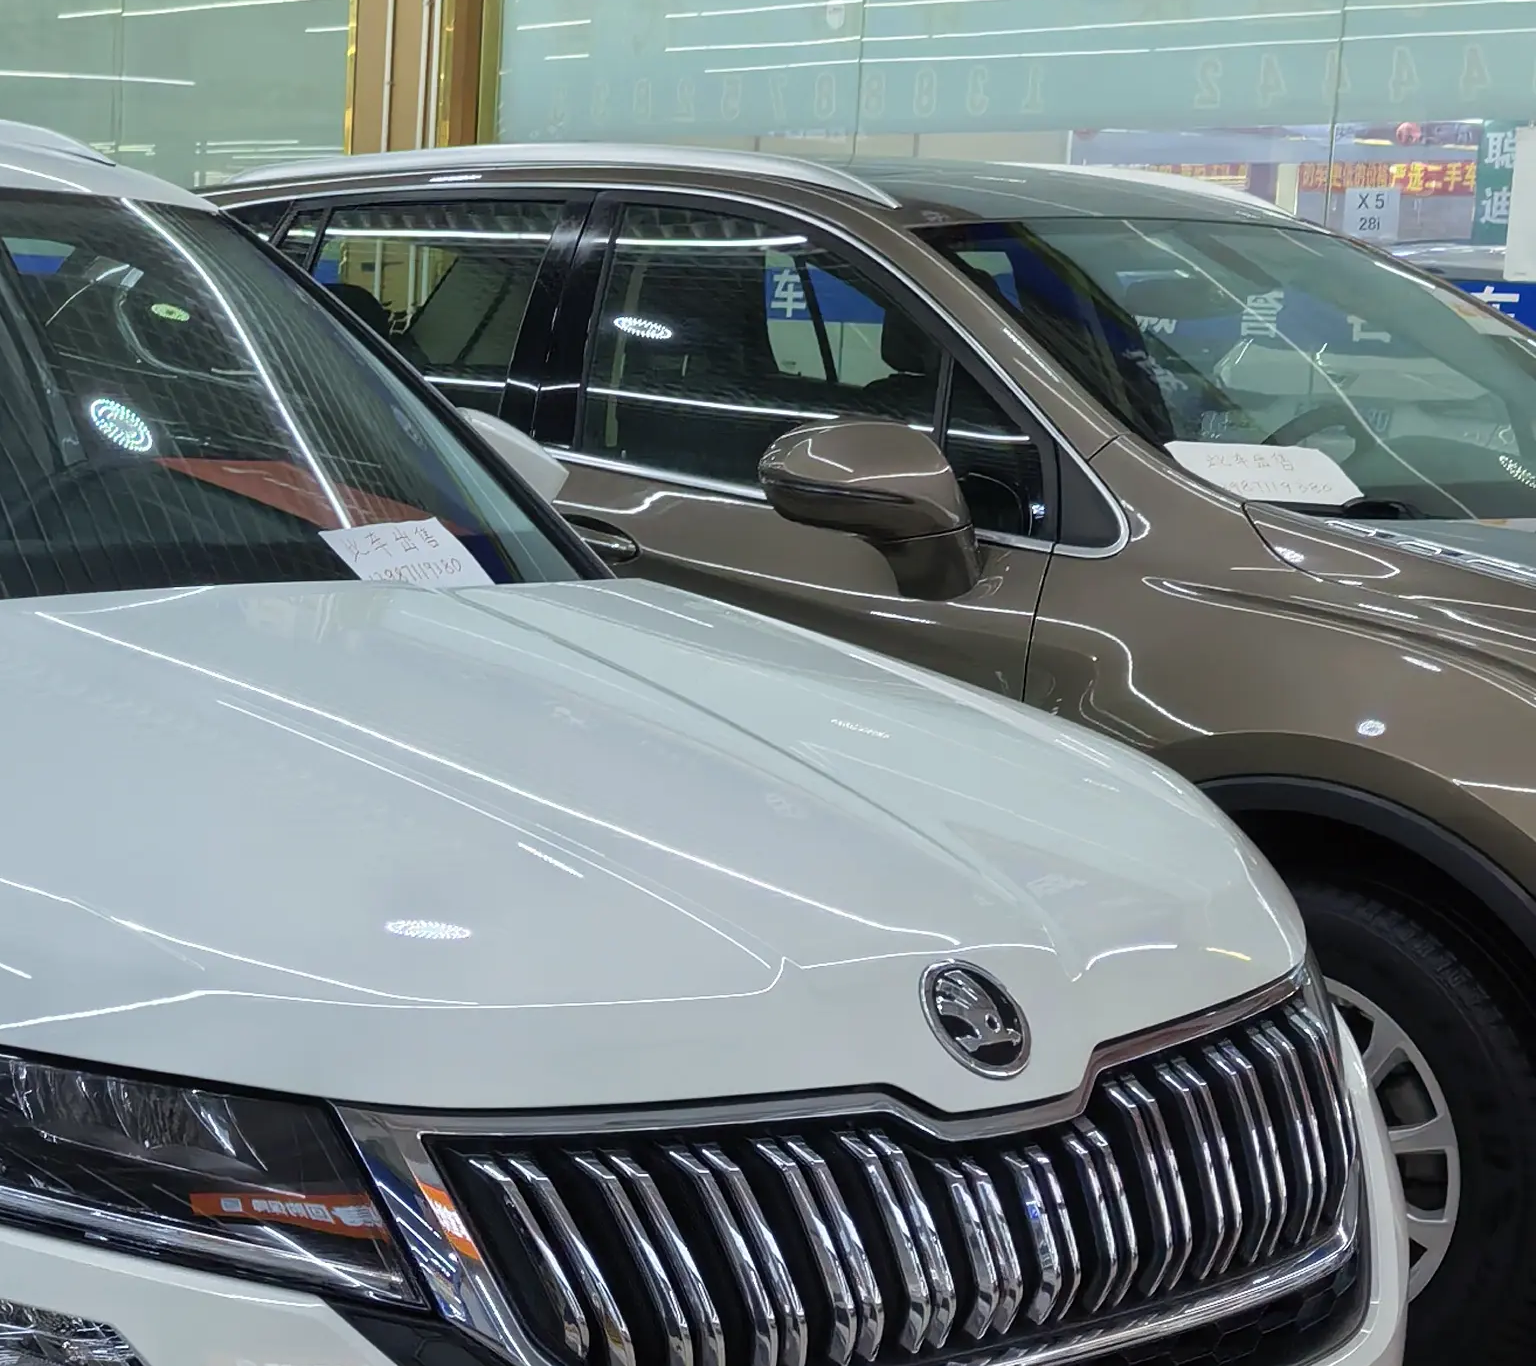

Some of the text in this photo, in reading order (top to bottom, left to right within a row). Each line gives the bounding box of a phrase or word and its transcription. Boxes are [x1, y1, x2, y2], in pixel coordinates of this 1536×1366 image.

[1358, 217, 1381, 232] 28i
[770, 268, 808, 318] 车
[341, 525, 440, 563] 此车出售
